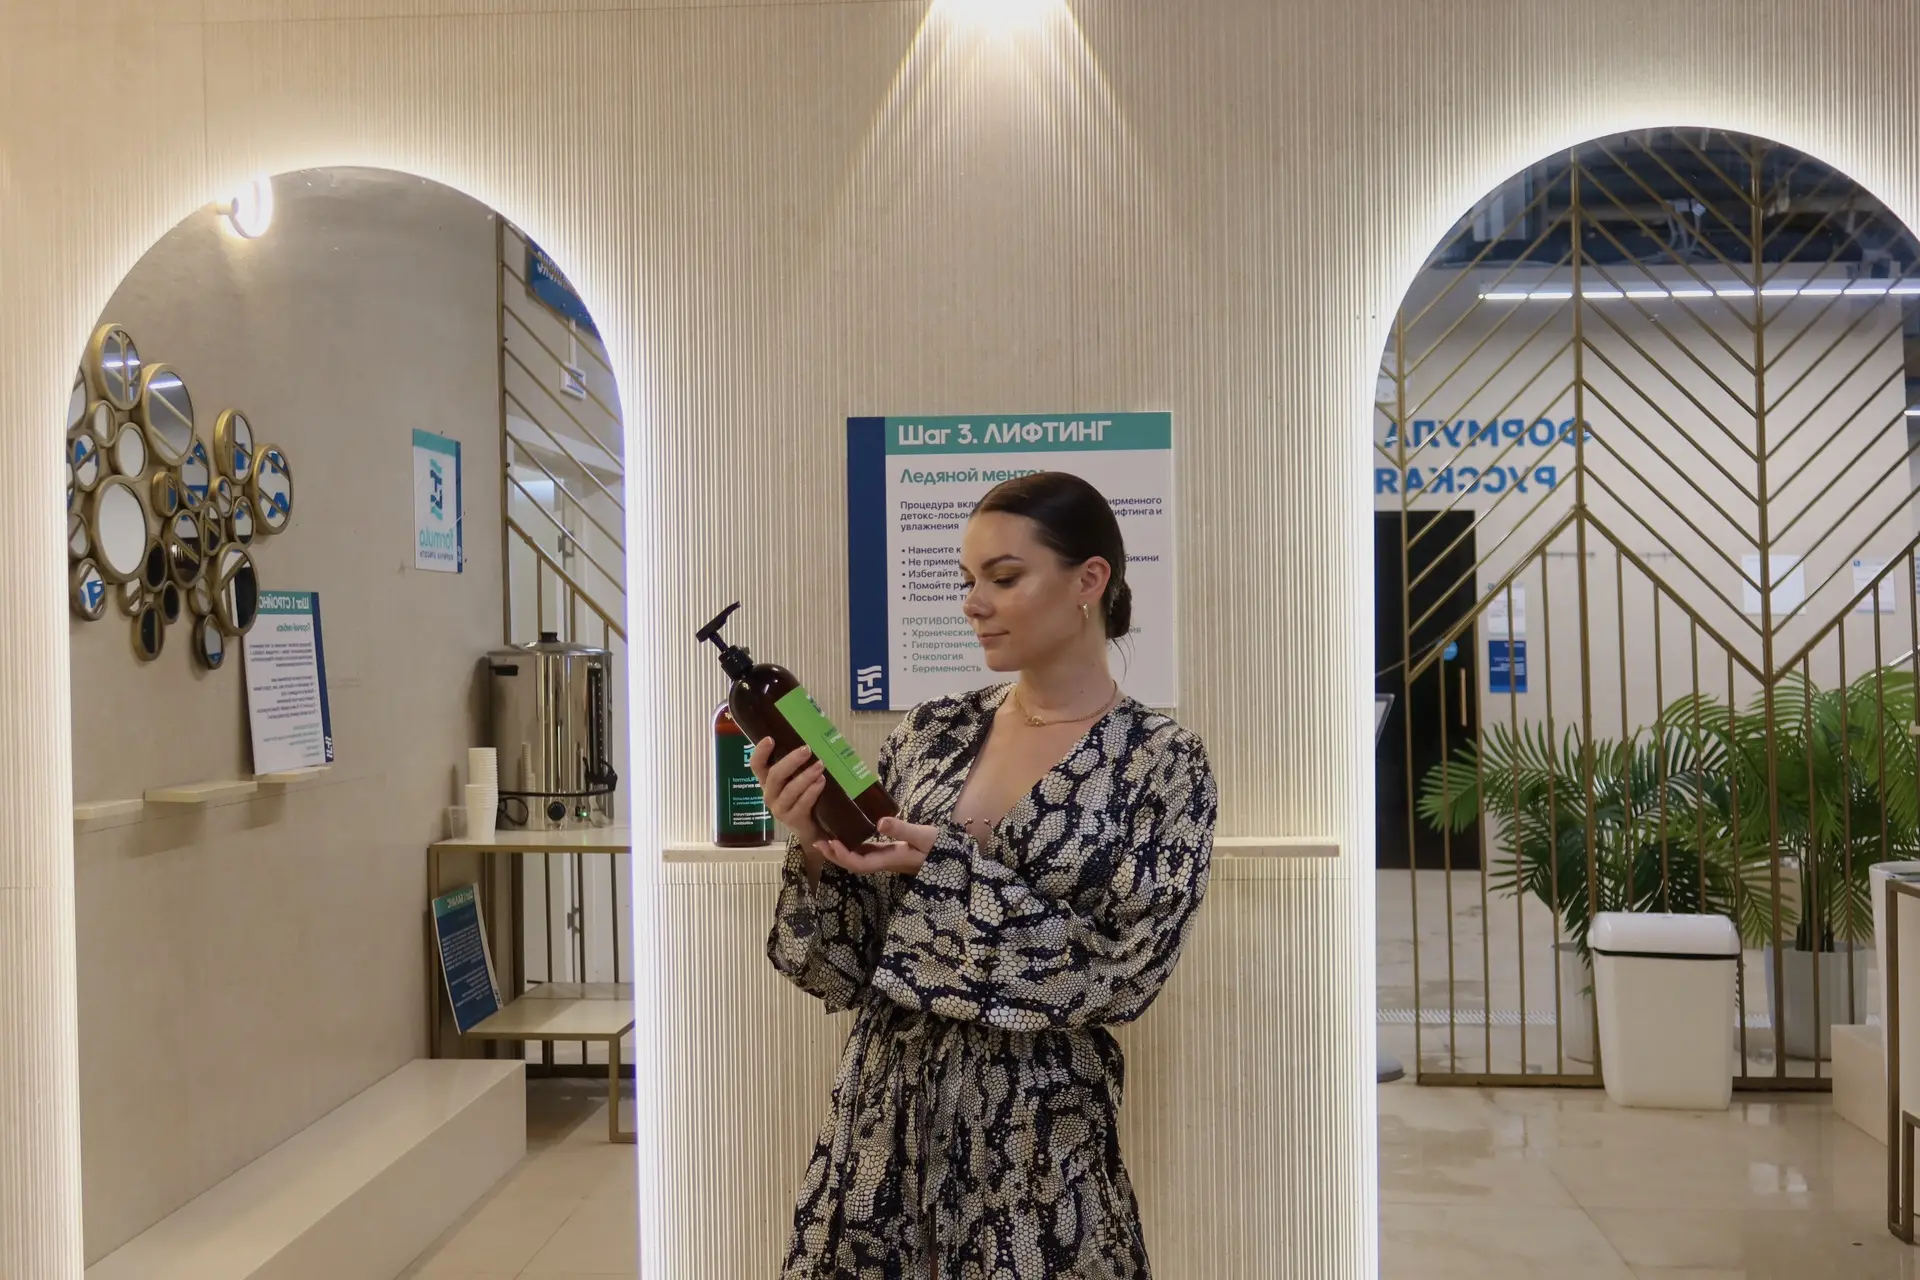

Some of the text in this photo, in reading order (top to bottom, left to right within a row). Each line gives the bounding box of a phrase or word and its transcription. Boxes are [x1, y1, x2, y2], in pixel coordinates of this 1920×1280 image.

[898, 420, 1112, 445] Шаг 3. ЛИФТИНГ
[900, 467, 978, 486] Ледяной
[900, 501, 954, 511] Процедура
[1111, 507, 1154, 517] ифтинга
[900, 523, 959, 532] увлажнения
[908, 546, 954, 554] Нанесите
[908, 558, 921, 566] Не
[908, 569, 958, 578] Избегайте
[908, 581, 951, 590] Помойте
[908, 593, 944, 602] Лосьон
[911, 629, 975, 638] Хронические
[911, 652, 964, 661] Онкология
[912, 664, 982, 674] Беременность
